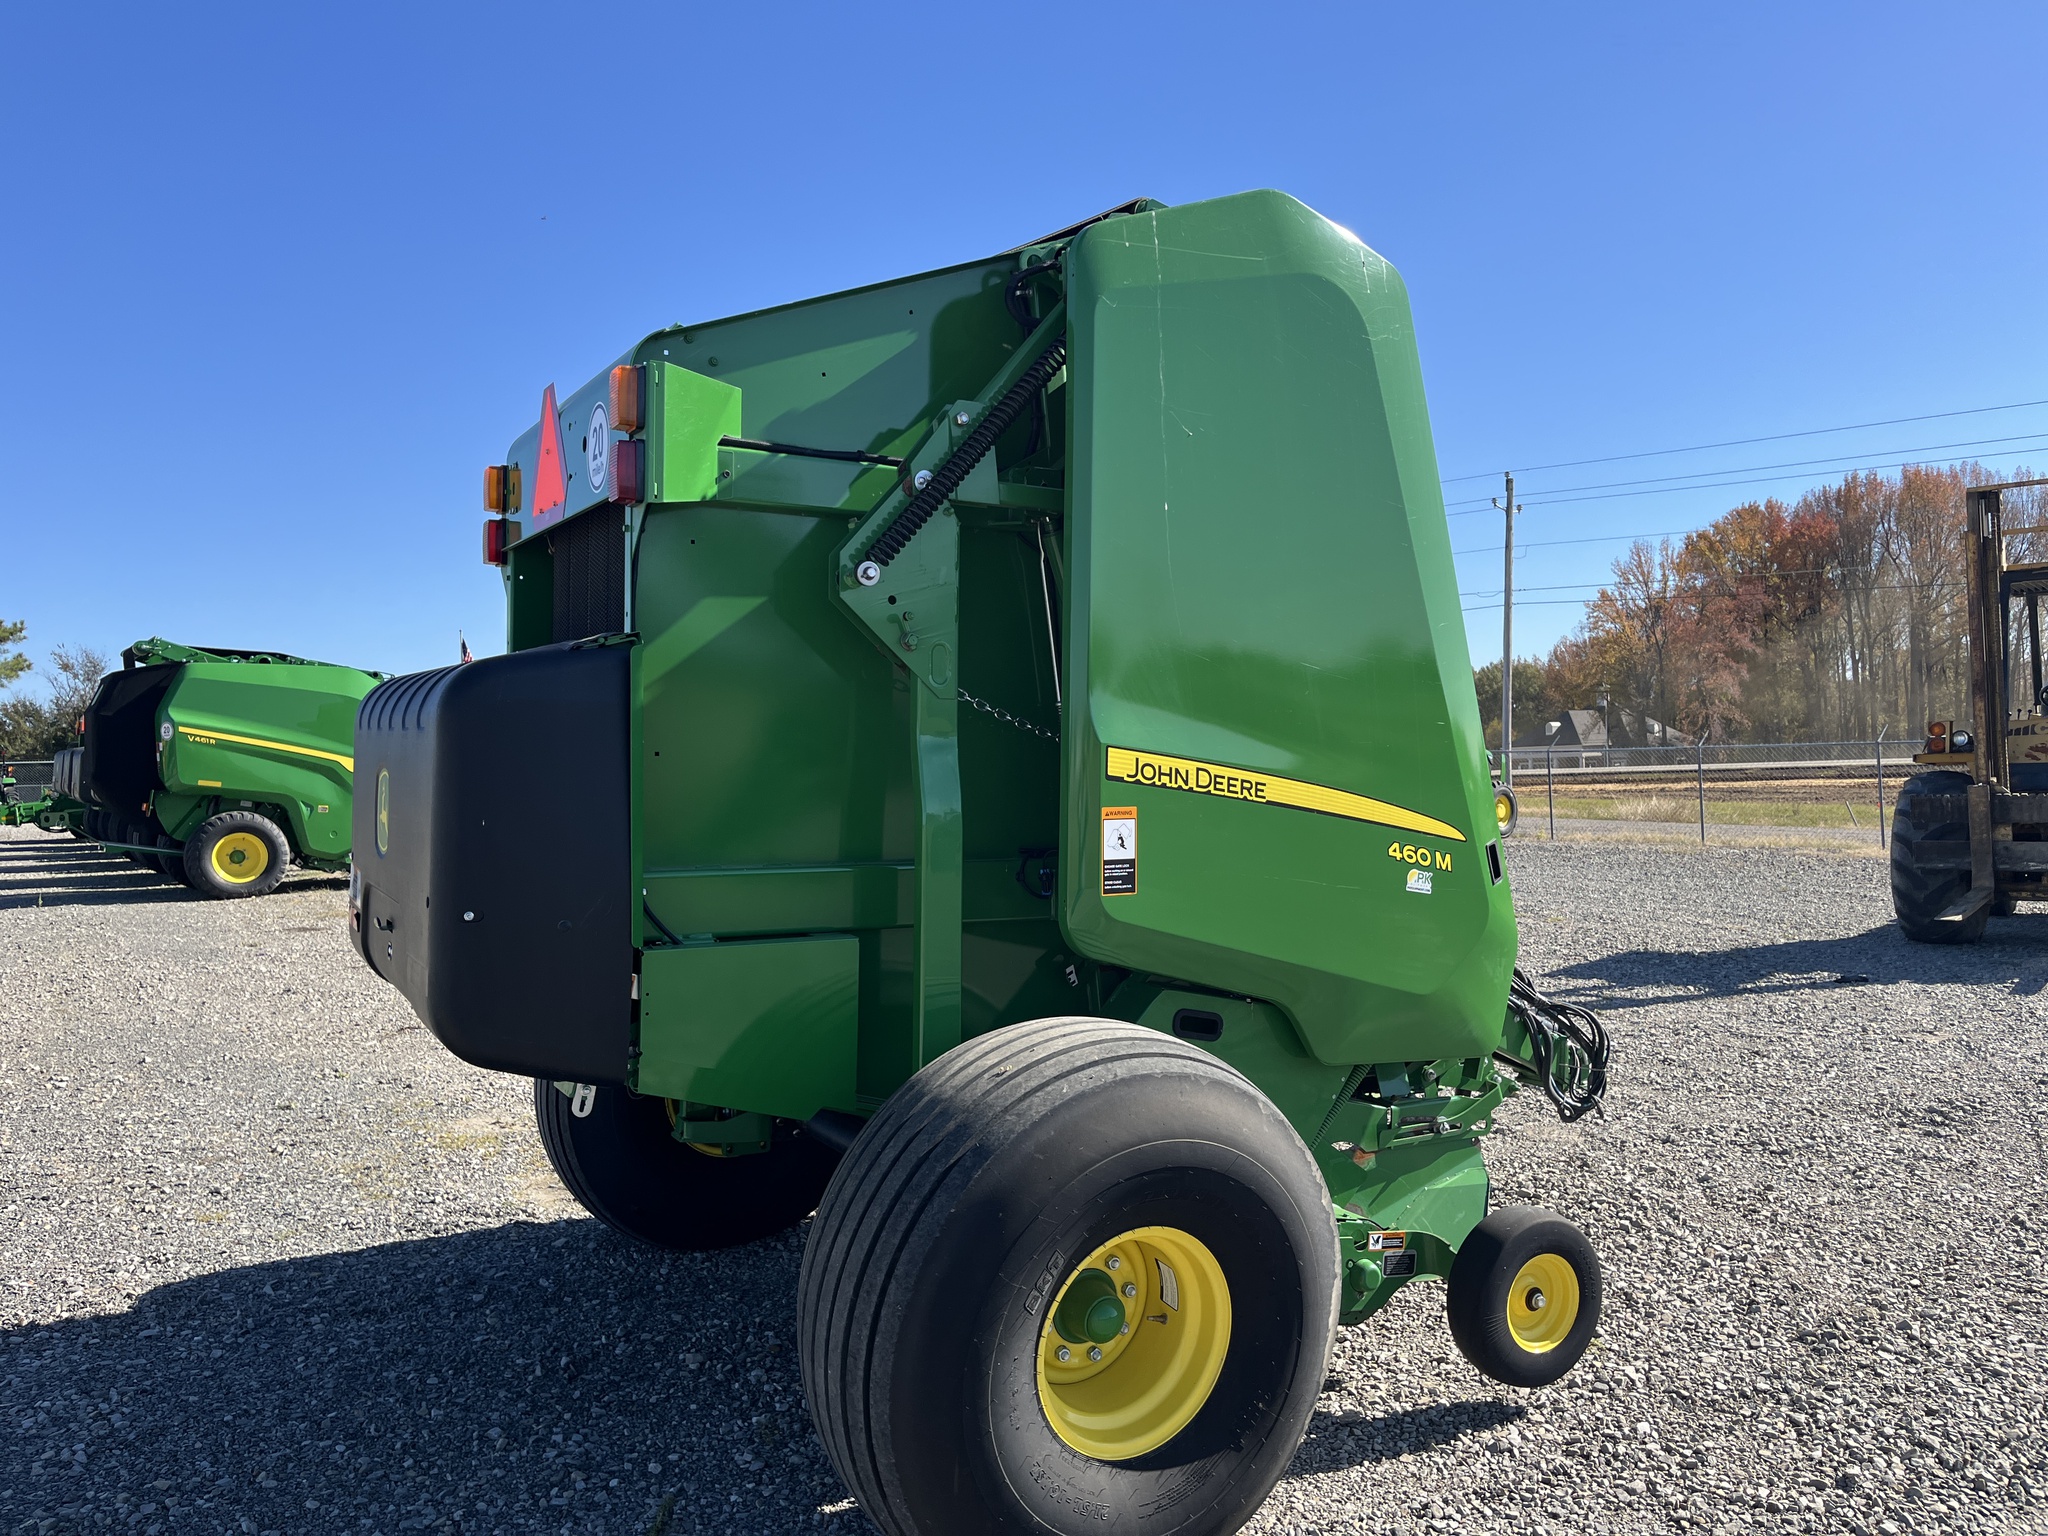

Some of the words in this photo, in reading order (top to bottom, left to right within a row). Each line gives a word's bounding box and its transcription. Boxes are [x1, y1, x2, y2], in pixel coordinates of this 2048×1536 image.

[592, 422, 604, 461] 20
[163, 725, 170, 734] 20
[1126, 757, 1189, 787] JOHN
[1195, 767, 1267, 799] DEERE
[1388, 841, 1432, 867] 460
[1435, 850, 1452, 872] M
[1416, 872, 1432, 885] PK
